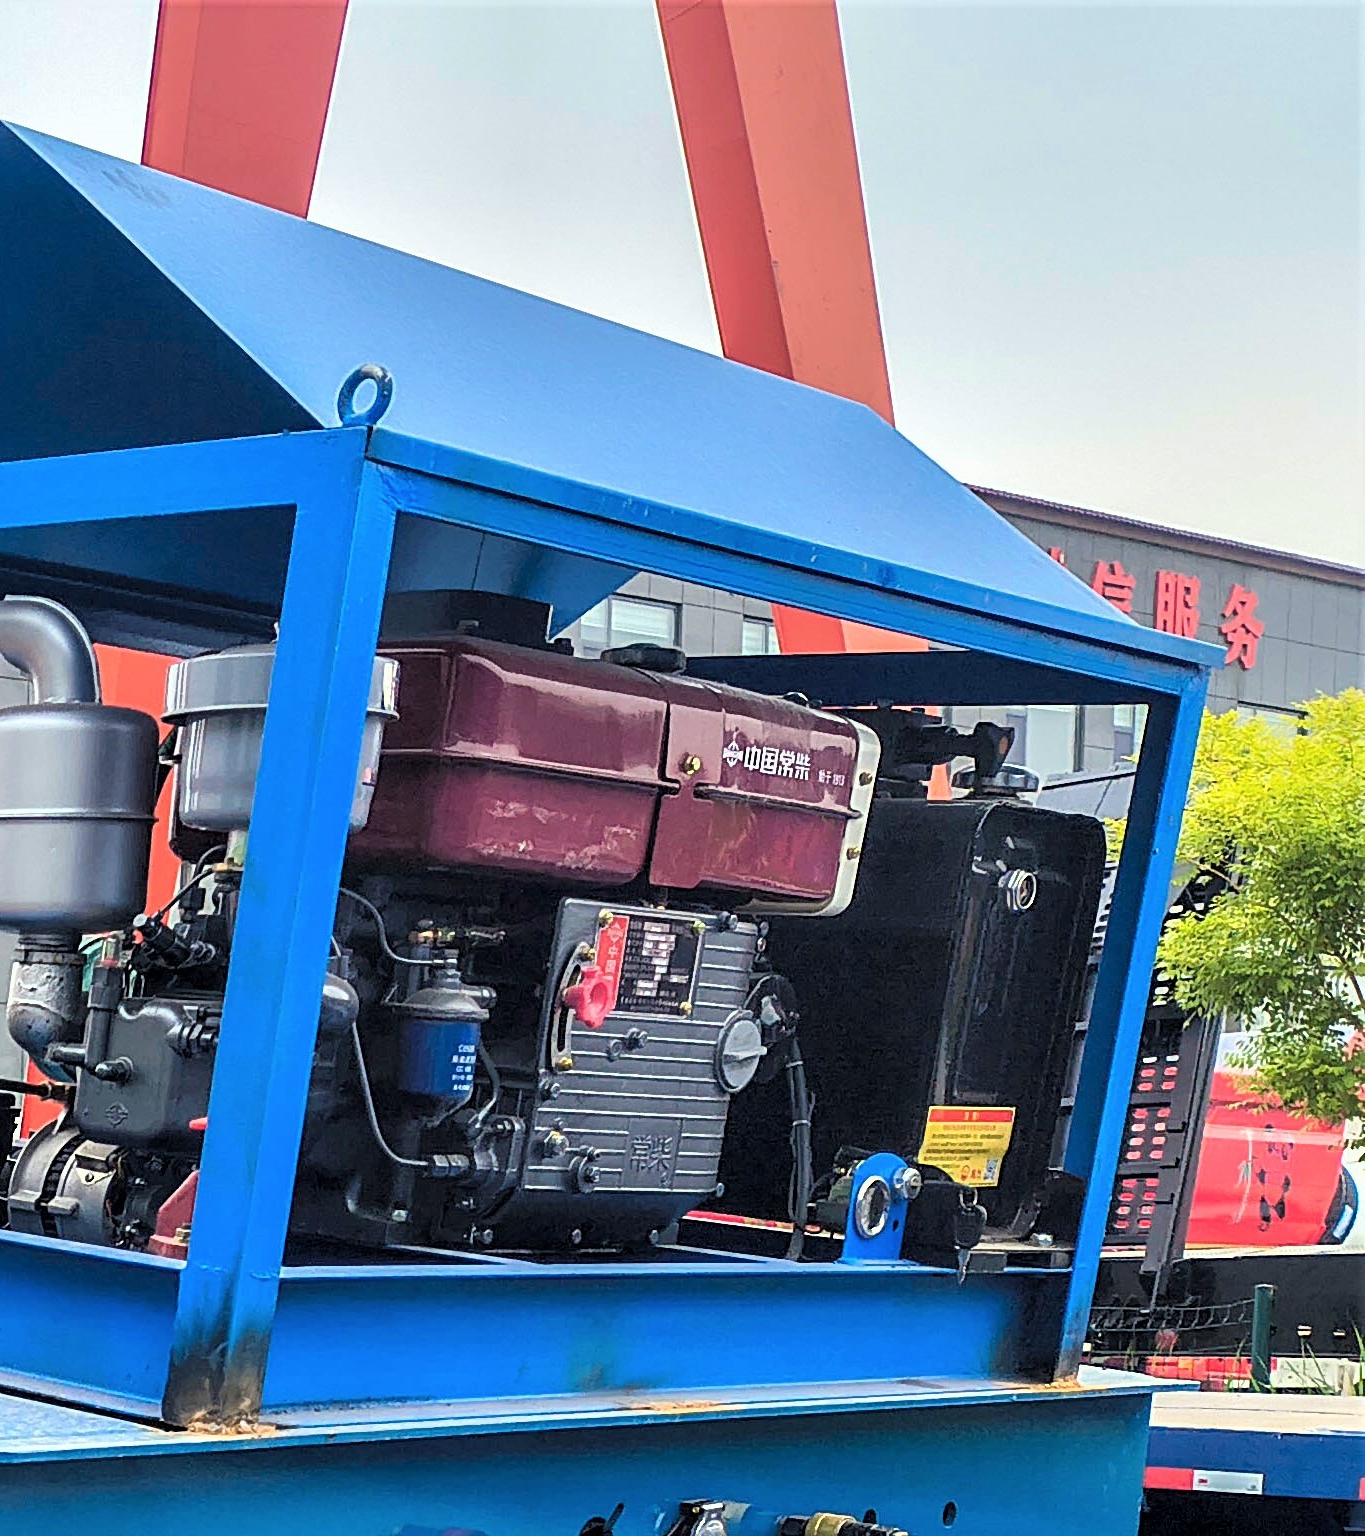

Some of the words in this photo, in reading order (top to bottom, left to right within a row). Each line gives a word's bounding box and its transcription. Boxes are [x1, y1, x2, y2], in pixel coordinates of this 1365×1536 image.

[1047, 547, 1265, 671] 信服务
[743, 746, 812, 781] 中国常柴
